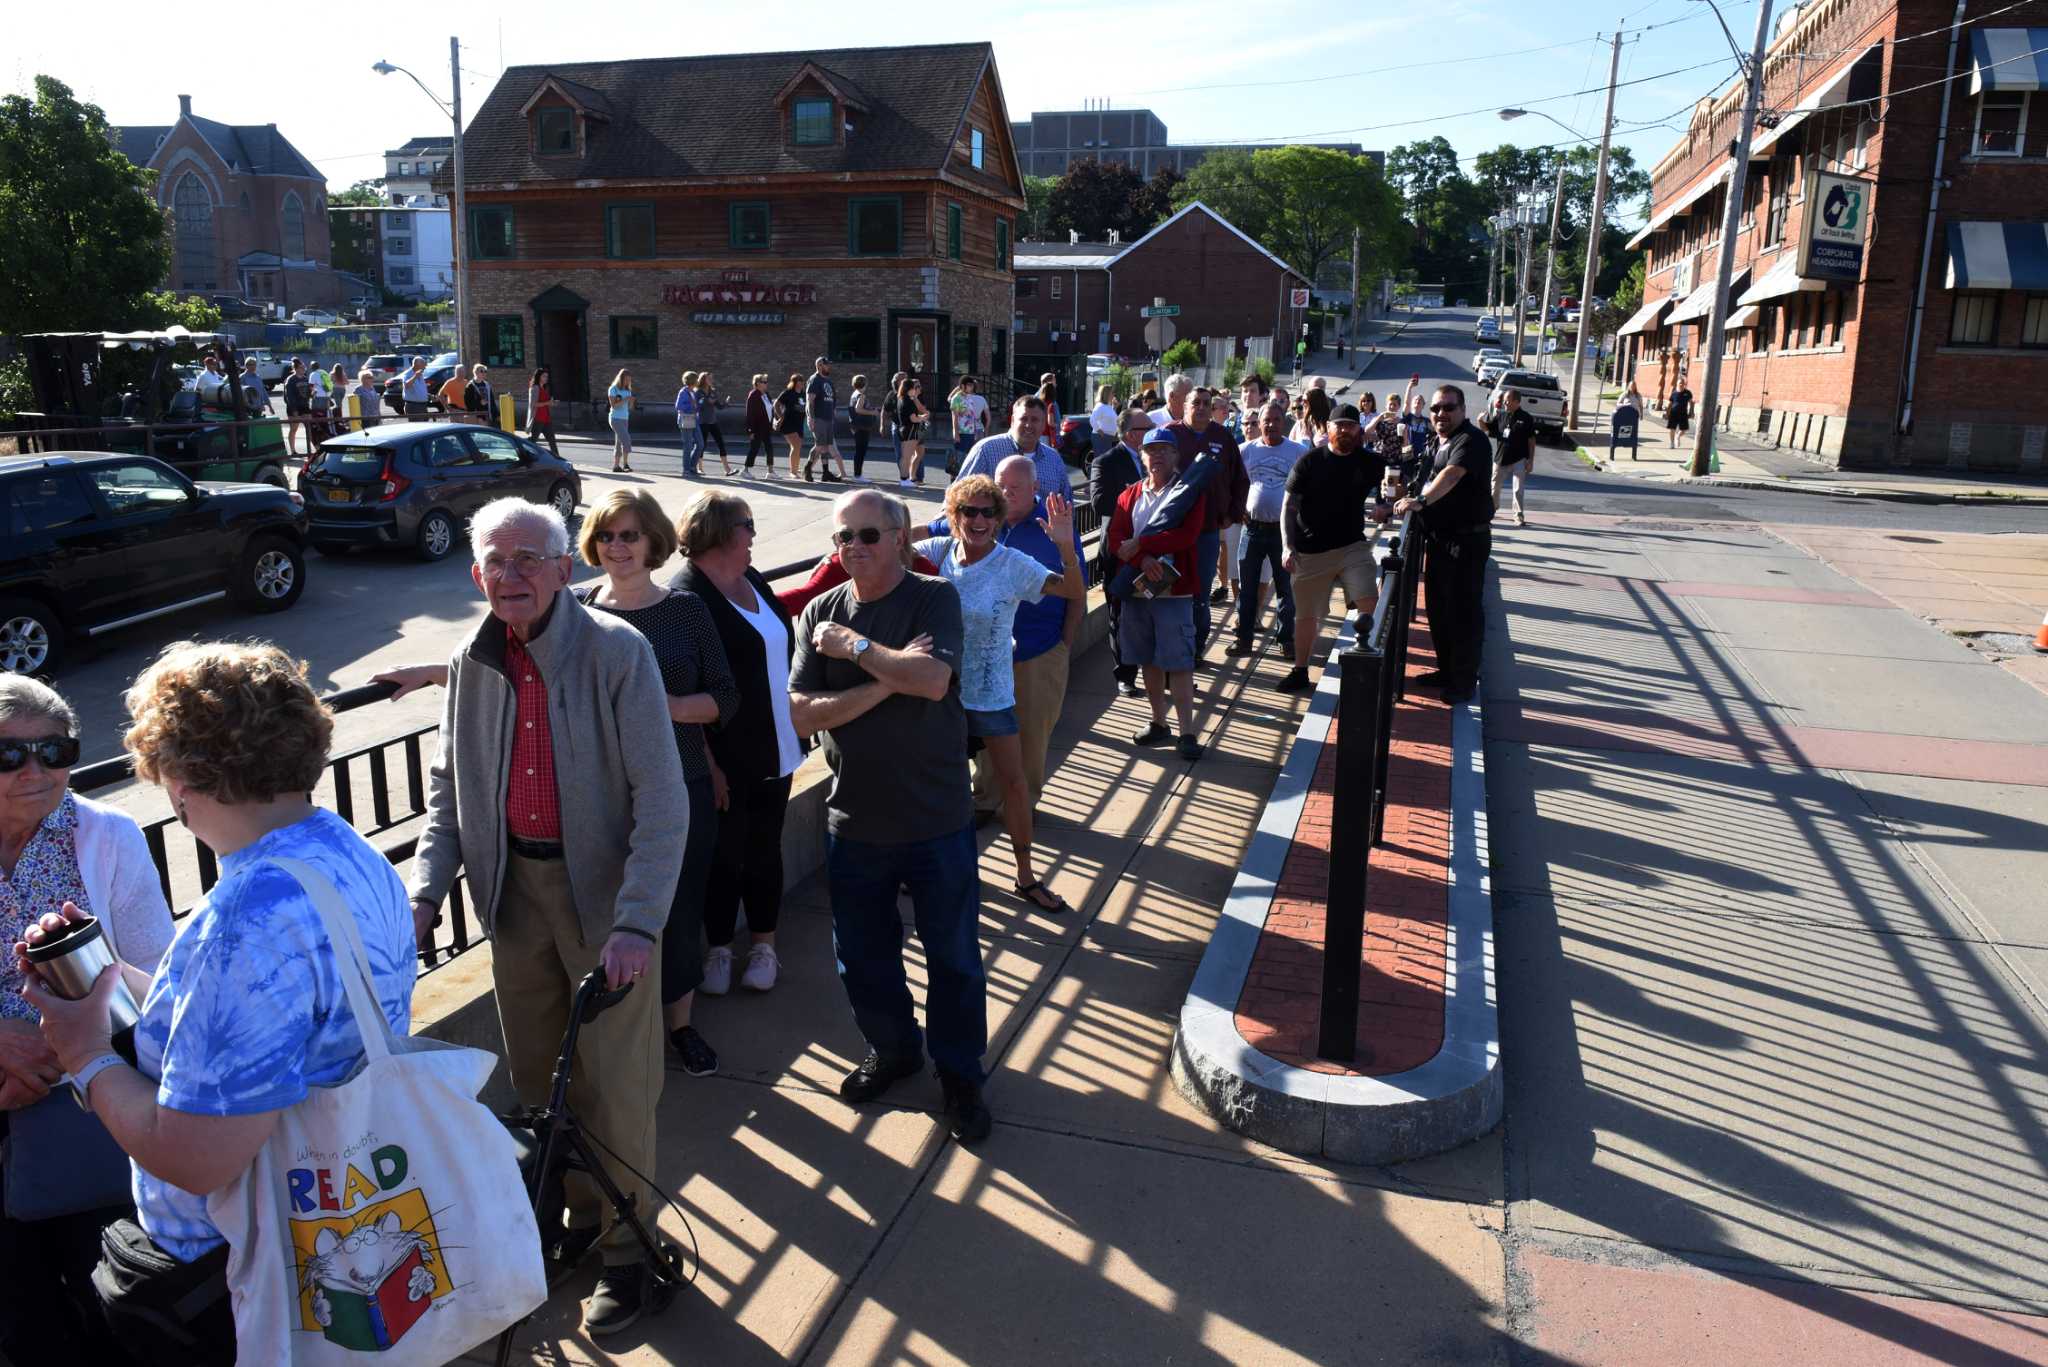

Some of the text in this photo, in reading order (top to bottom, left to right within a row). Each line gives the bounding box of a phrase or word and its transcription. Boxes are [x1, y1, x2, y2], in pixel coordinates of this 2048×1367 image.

[1816, 247, 1855, 258] CORPORATE
[1811, 257, 1859, 269] HEADQUARTERS
[296, 1145, 325, 1162] When
[328, 1151, 339, 1161] in
